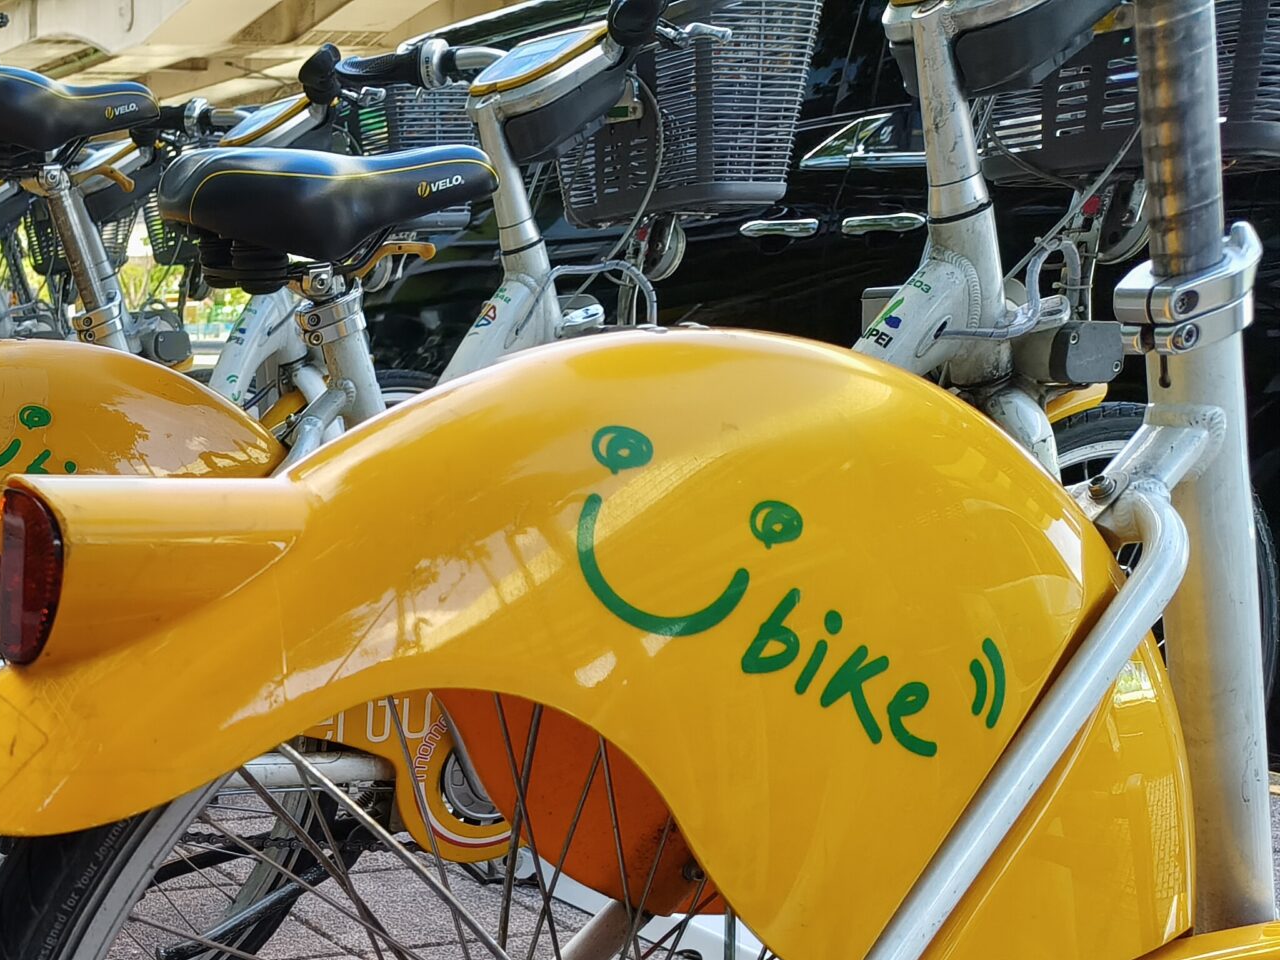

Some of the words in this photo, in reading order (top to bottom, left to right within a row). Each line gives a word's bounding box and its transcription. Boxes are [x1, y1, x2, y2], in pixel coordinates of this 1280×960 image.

[113, 103, 137, 116] VELO
[430, 175, 463, 192] VELO
[62, 888, 80, 912] for
[75, 860, 99, 893] Your
